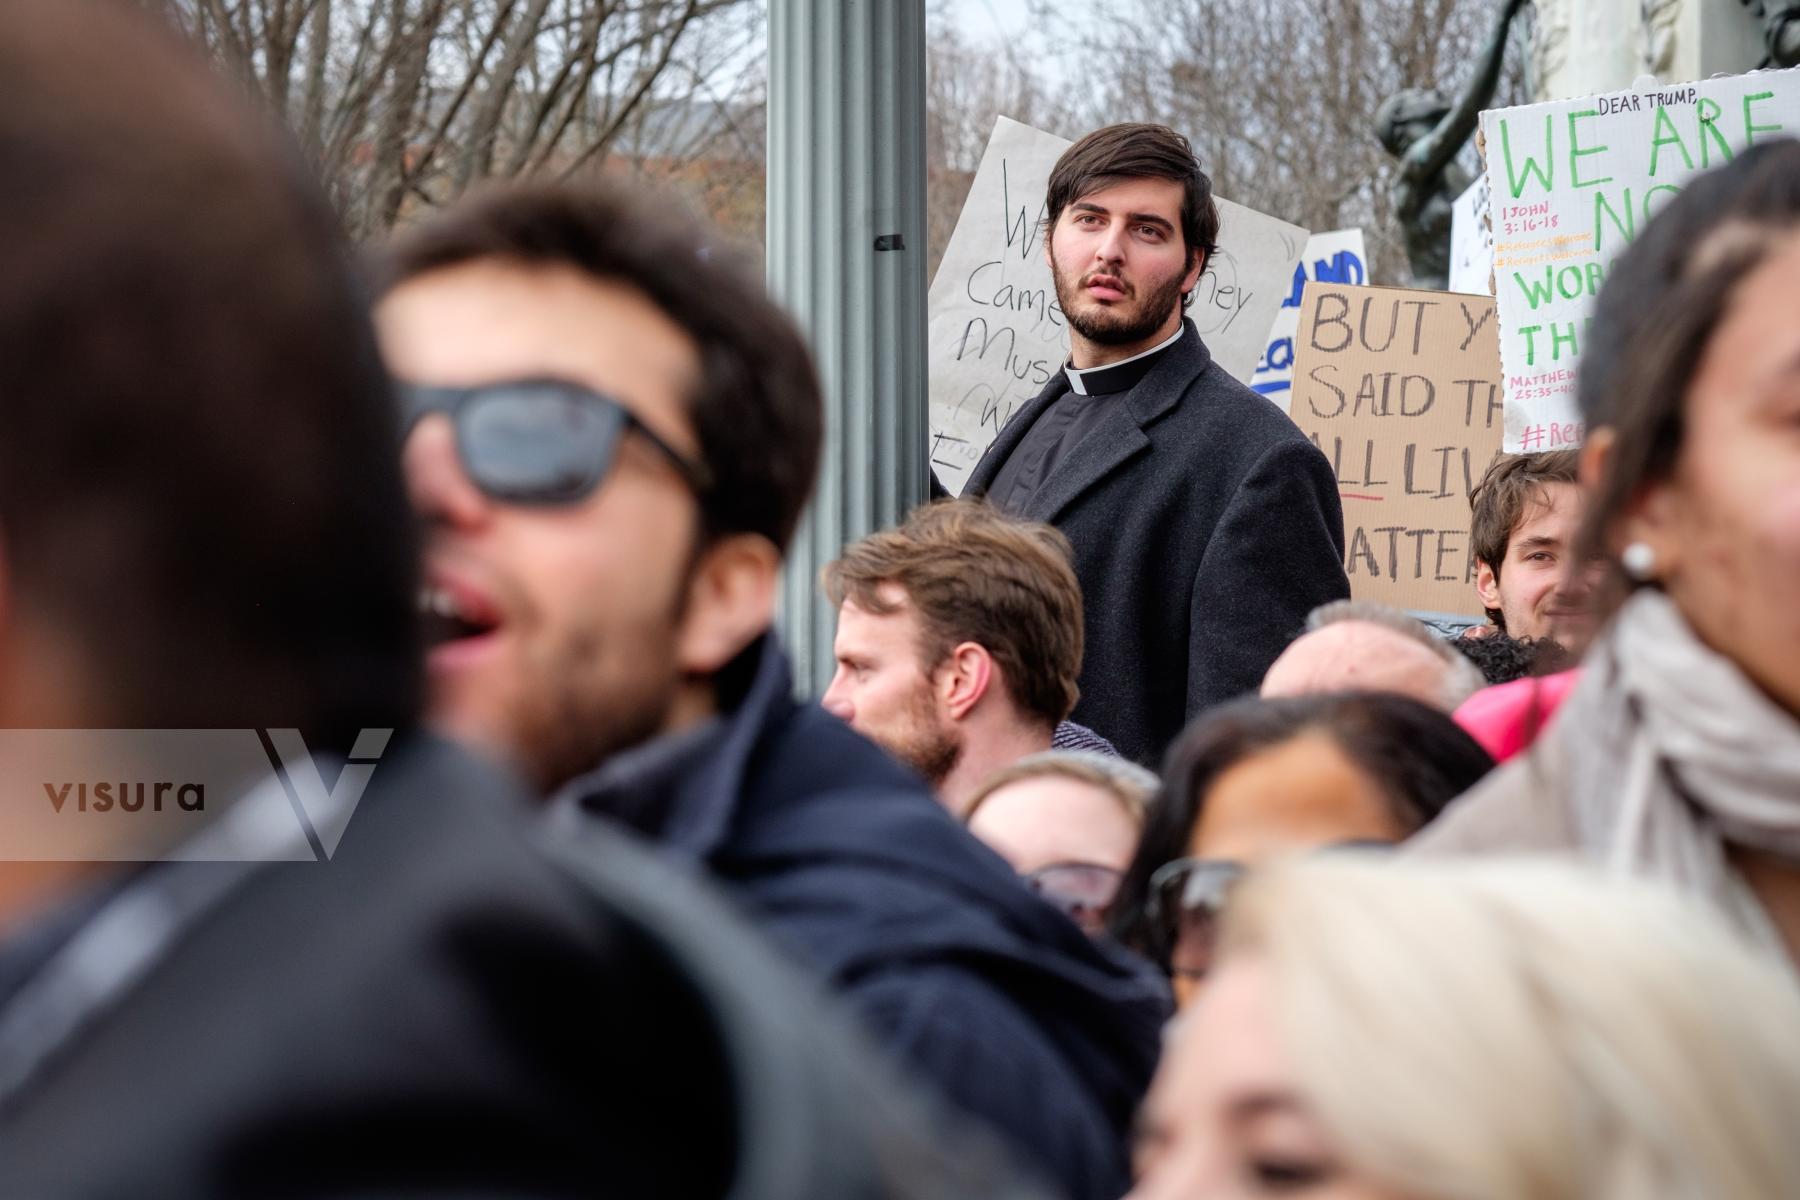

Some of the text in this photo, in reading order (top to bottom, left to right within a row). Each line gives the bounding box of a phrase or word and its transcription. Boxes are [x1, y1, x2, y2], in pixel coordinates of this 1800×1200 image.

[1599, 88, 1698, 116] DEAR TRUMP,
[1499, 109, 1613, 199] WE
[1510, 200, 1549, 218] JOHN
[1504, 214, 1559, 235] 3:16-18
[967, 260, 1063, 327] Came
[1311, 293, 1440, 355] BUT
[1308, 364, 1436, 418] SAID
[1510, 368, 1577, 389] MATTHEW
[1515, 384, 1577, 401] 25:35-40
